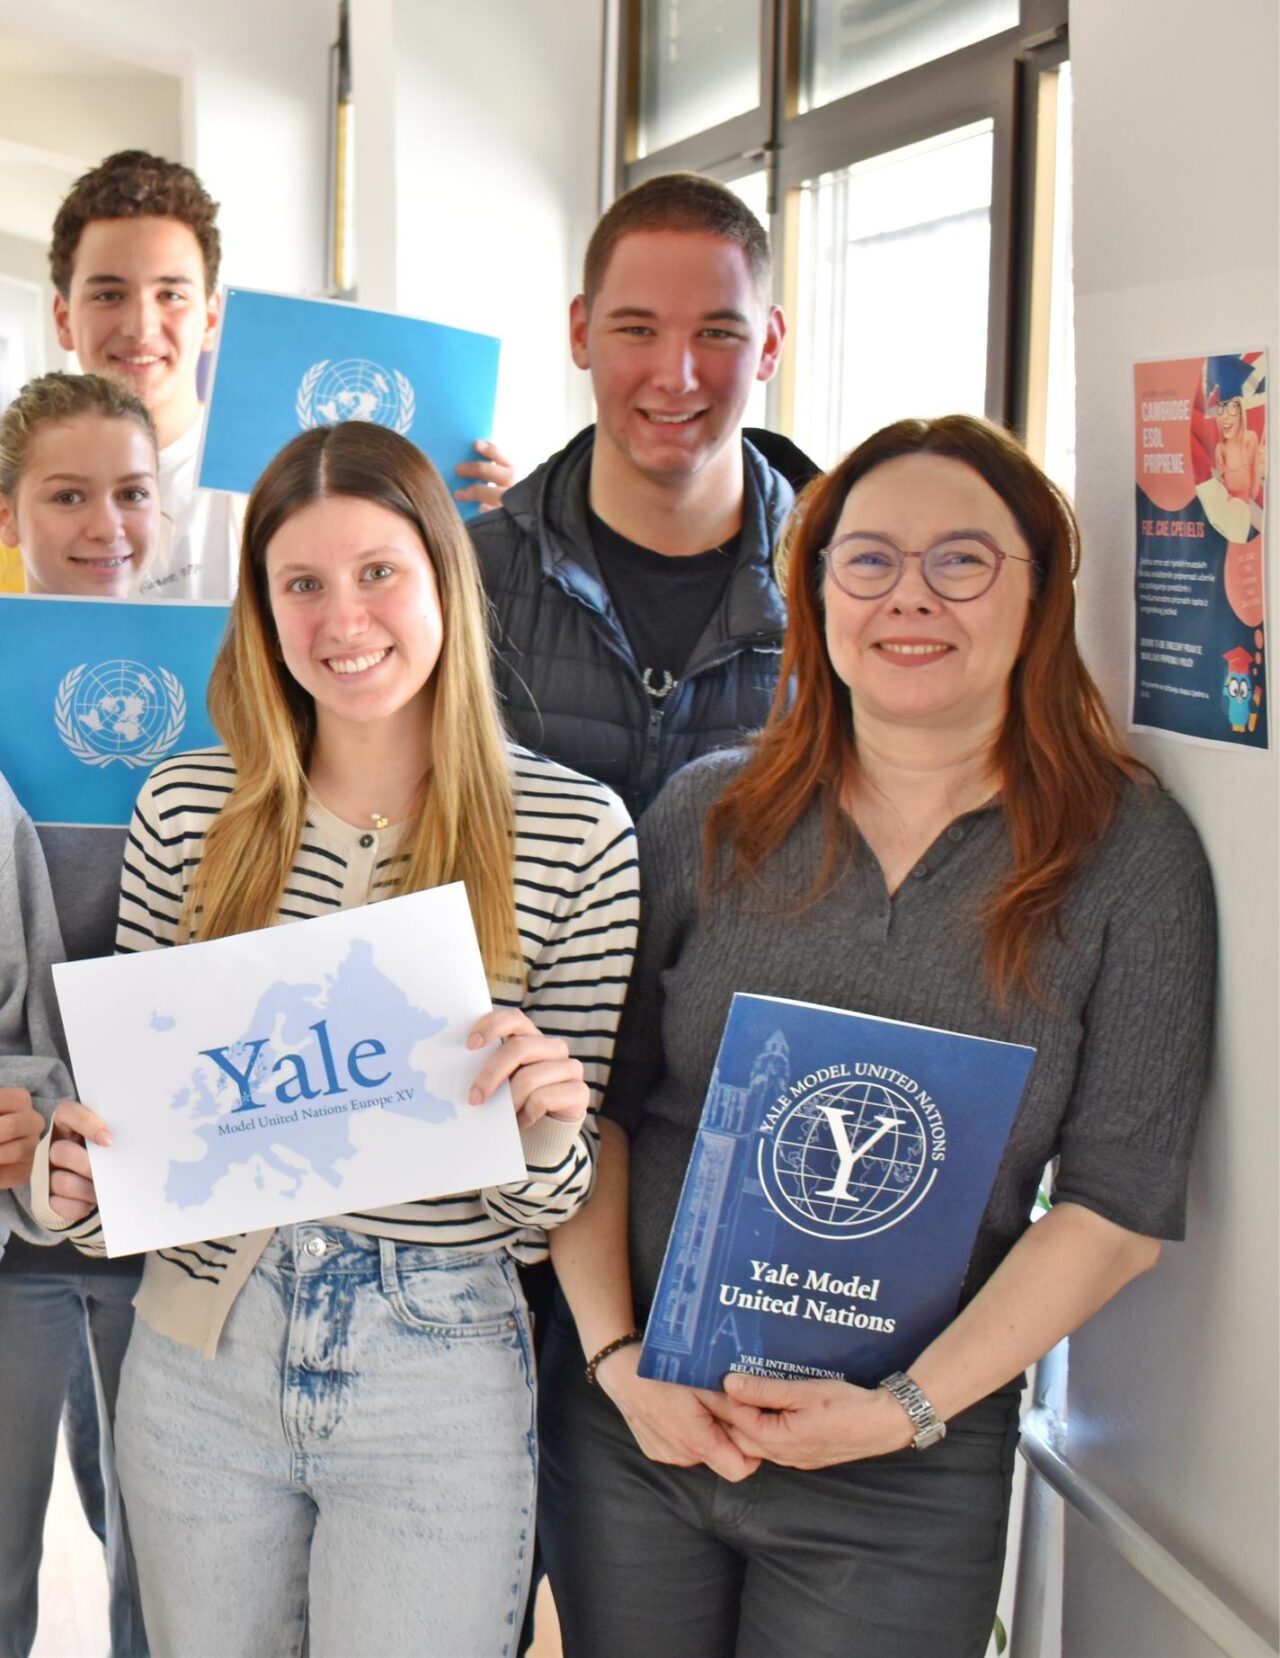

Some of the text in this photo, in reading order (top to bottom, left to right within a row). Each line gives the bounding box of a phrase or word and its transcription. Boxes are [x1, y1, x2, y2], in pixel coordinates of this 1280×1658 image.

[1142, 399, 1190, 421] CAMBRIDGE
[1143, 427, 1164, 448] ESOL
[1144, 453, 1184, 474] PRIPREME
[198, 1019, 393, 1114] Yale
[218, 1088, 415, 1136] Model United Nations Europe XV
[760, 1062, 947, 1162] YALE MODEL UNITED NATIONS
[815, 1104, 907, 1202] Y
[750, 1259, 881, 1301] Yale Model
[719, 1284, 896, 1334] United Nations
[729, 1363, 786, 1380] RELATIONS
[740, 1353, 846, 1381] YALE INTERNATIONAL
